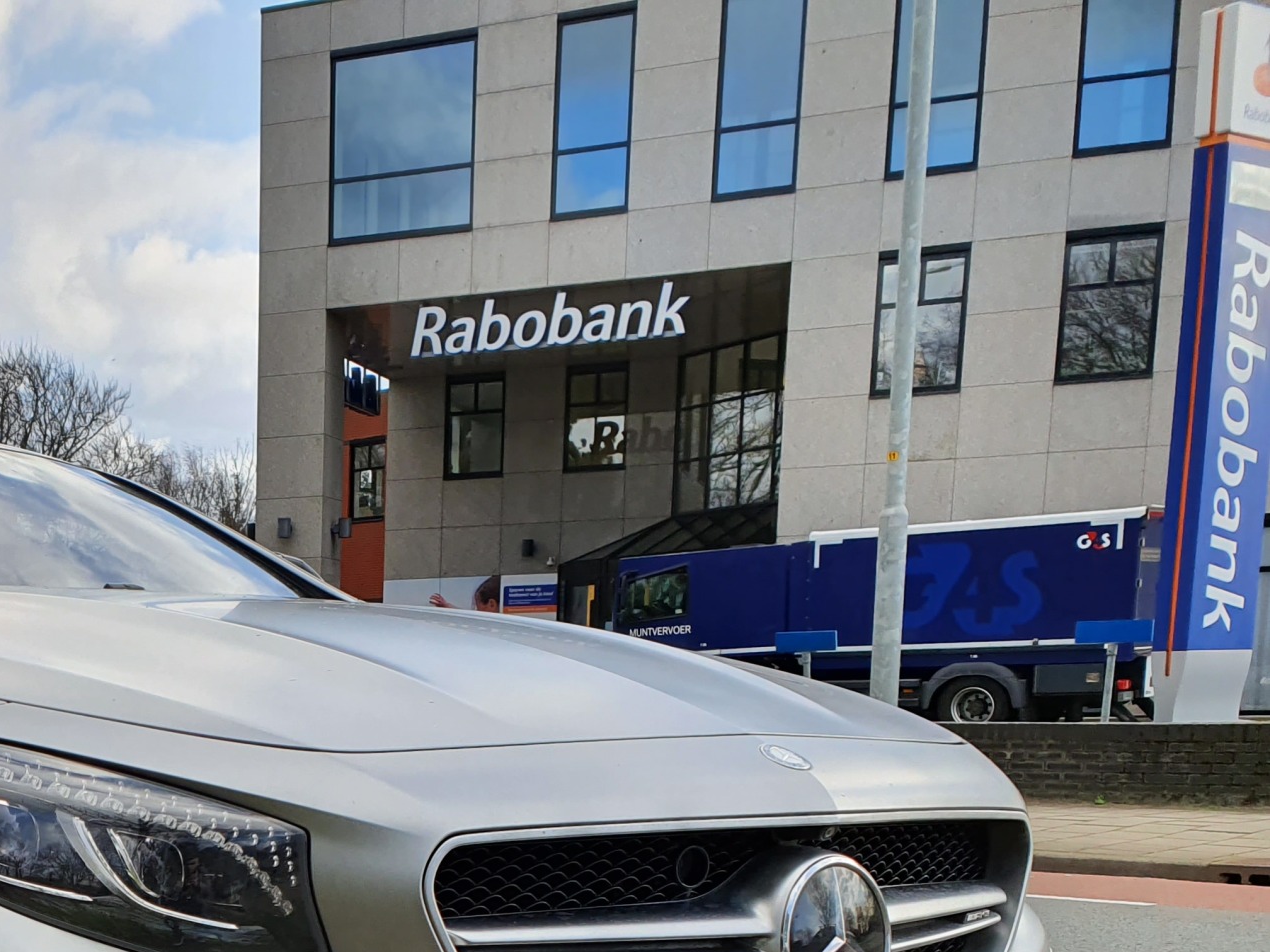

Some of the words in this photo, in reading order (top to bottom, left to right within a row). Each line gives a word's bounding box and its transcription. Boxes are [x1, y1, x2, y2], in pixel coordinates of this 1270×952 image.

[410, 280, 690, 358] Rabobank
[1202, 229, 1270, 632] Rabobank
[629, 624, 692, 638] MUNTVERVOER
